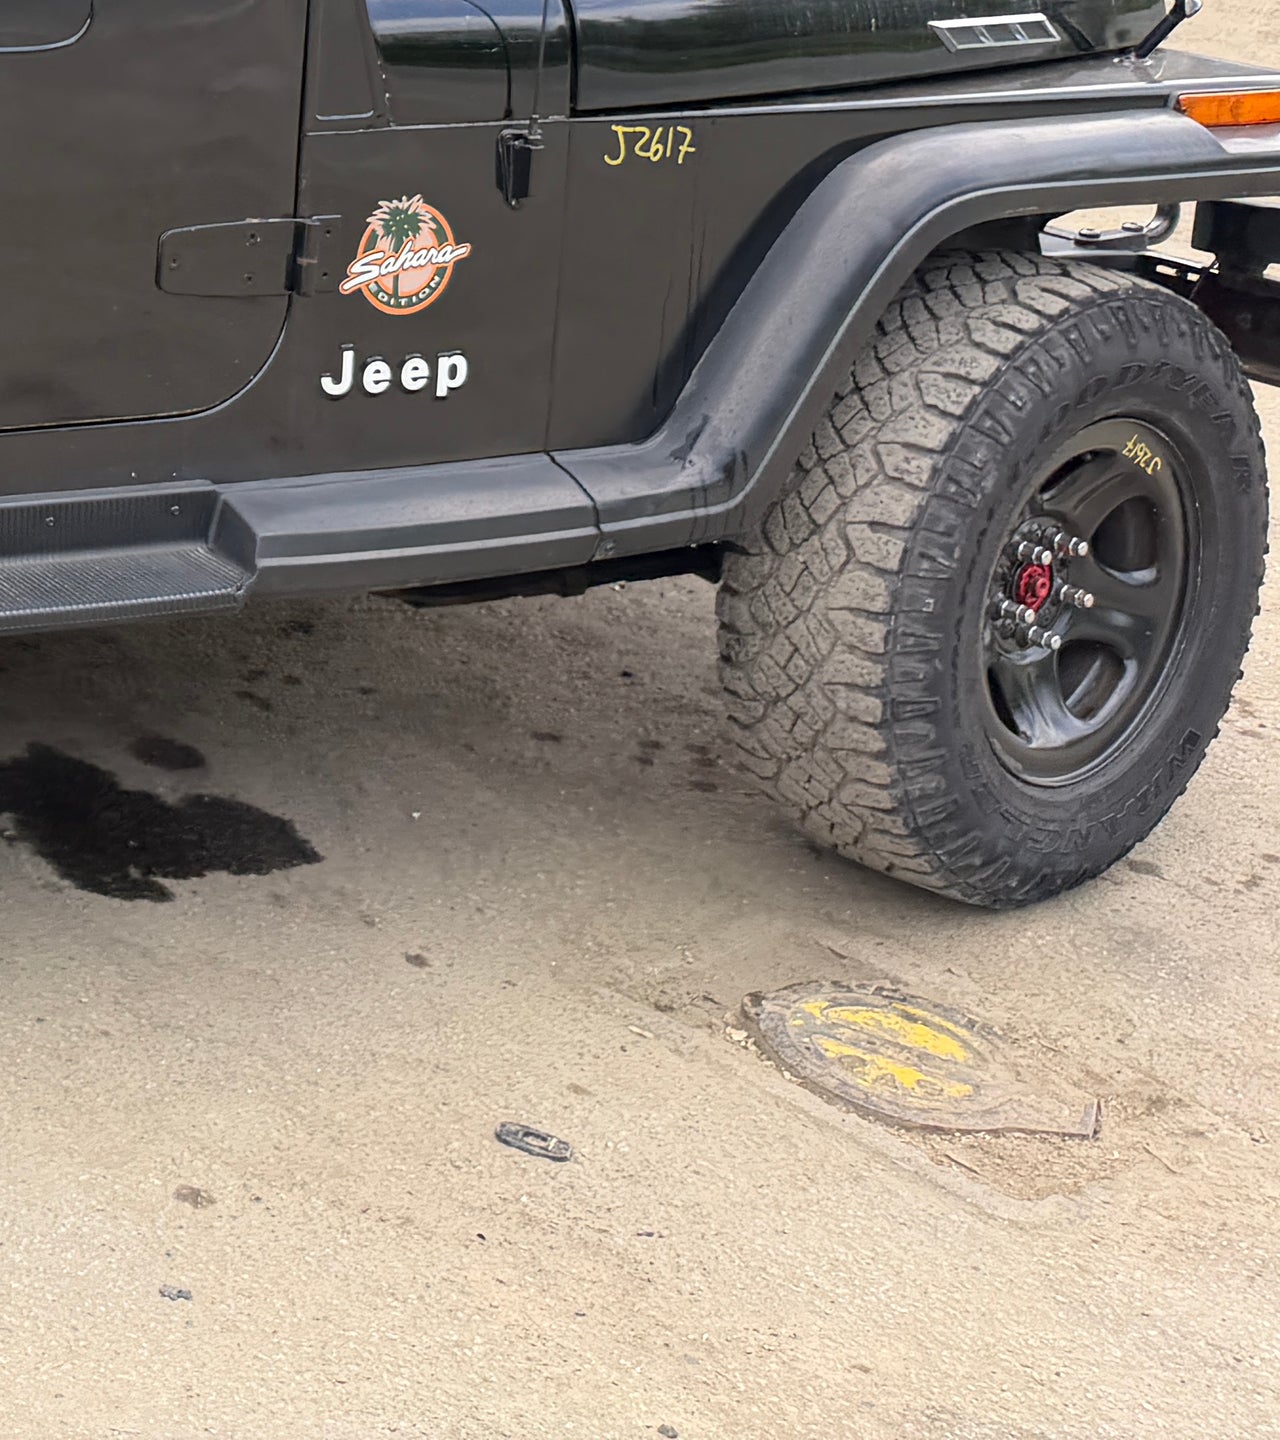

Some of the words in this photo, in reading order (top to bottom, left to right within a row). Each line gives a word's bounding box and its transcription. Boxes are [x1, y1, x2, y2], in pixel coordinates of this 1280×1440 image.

[604, 125, 696, 166] J2617
[341, 239, 468, 291] Sahara
[367, 274, 442, 307] EDITION
[320, 346, 470, 399] Jeep
[1122, 434, 1162, 475] J2617
